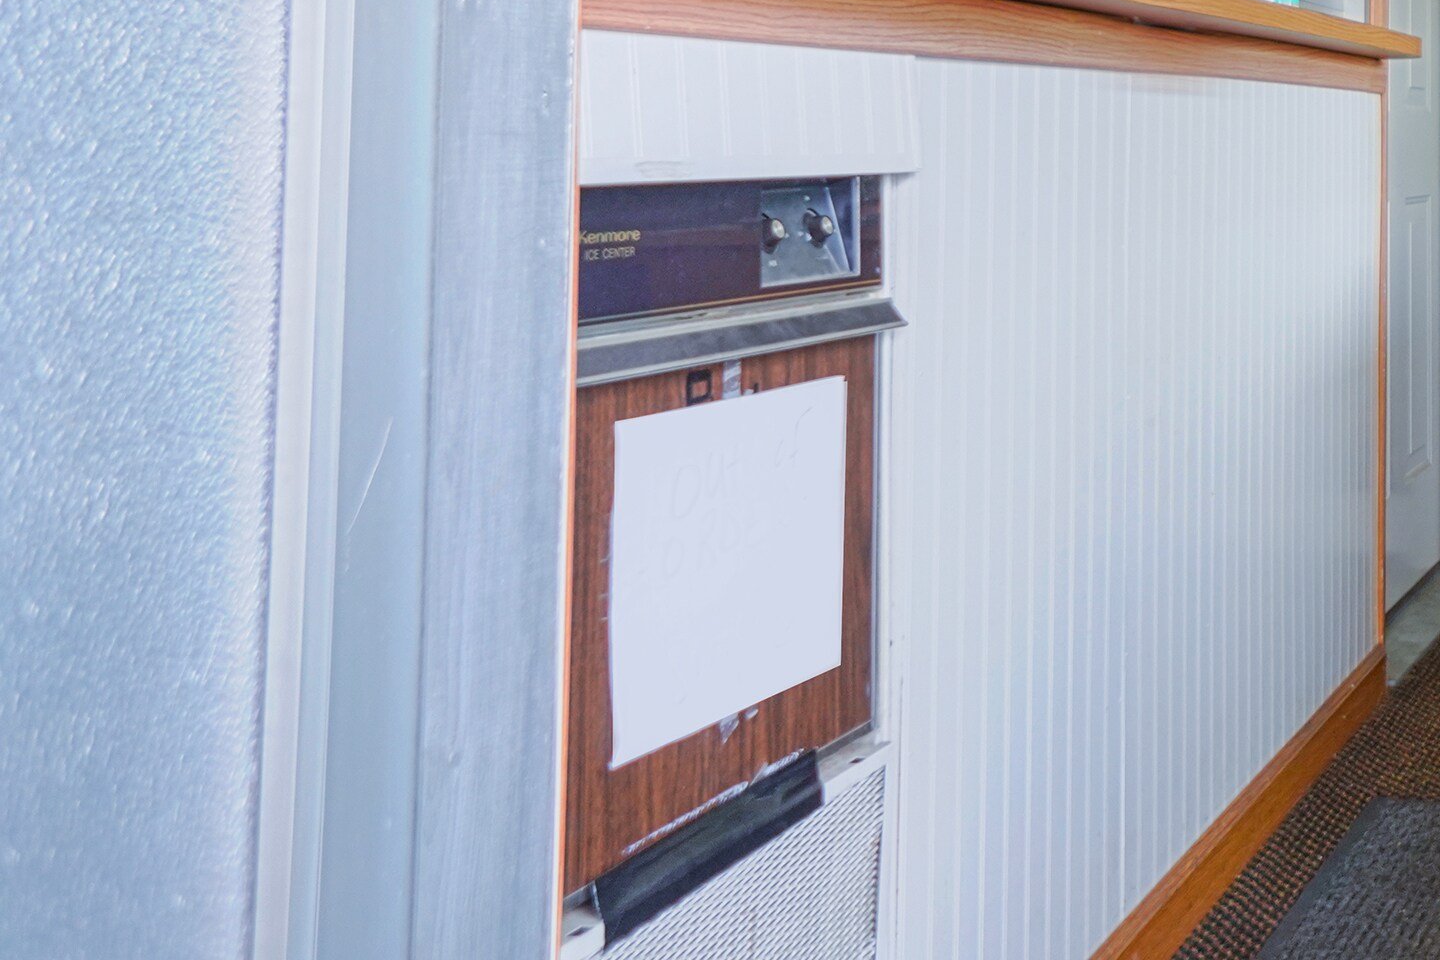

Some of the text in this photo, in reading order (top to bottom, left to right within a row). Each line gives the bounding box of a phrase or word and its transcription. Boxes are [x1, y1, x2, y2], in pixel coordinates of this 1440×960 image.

[580, 230, 641, 244] Kenmore
[586, 246, 636, 260] ICE CENTER
